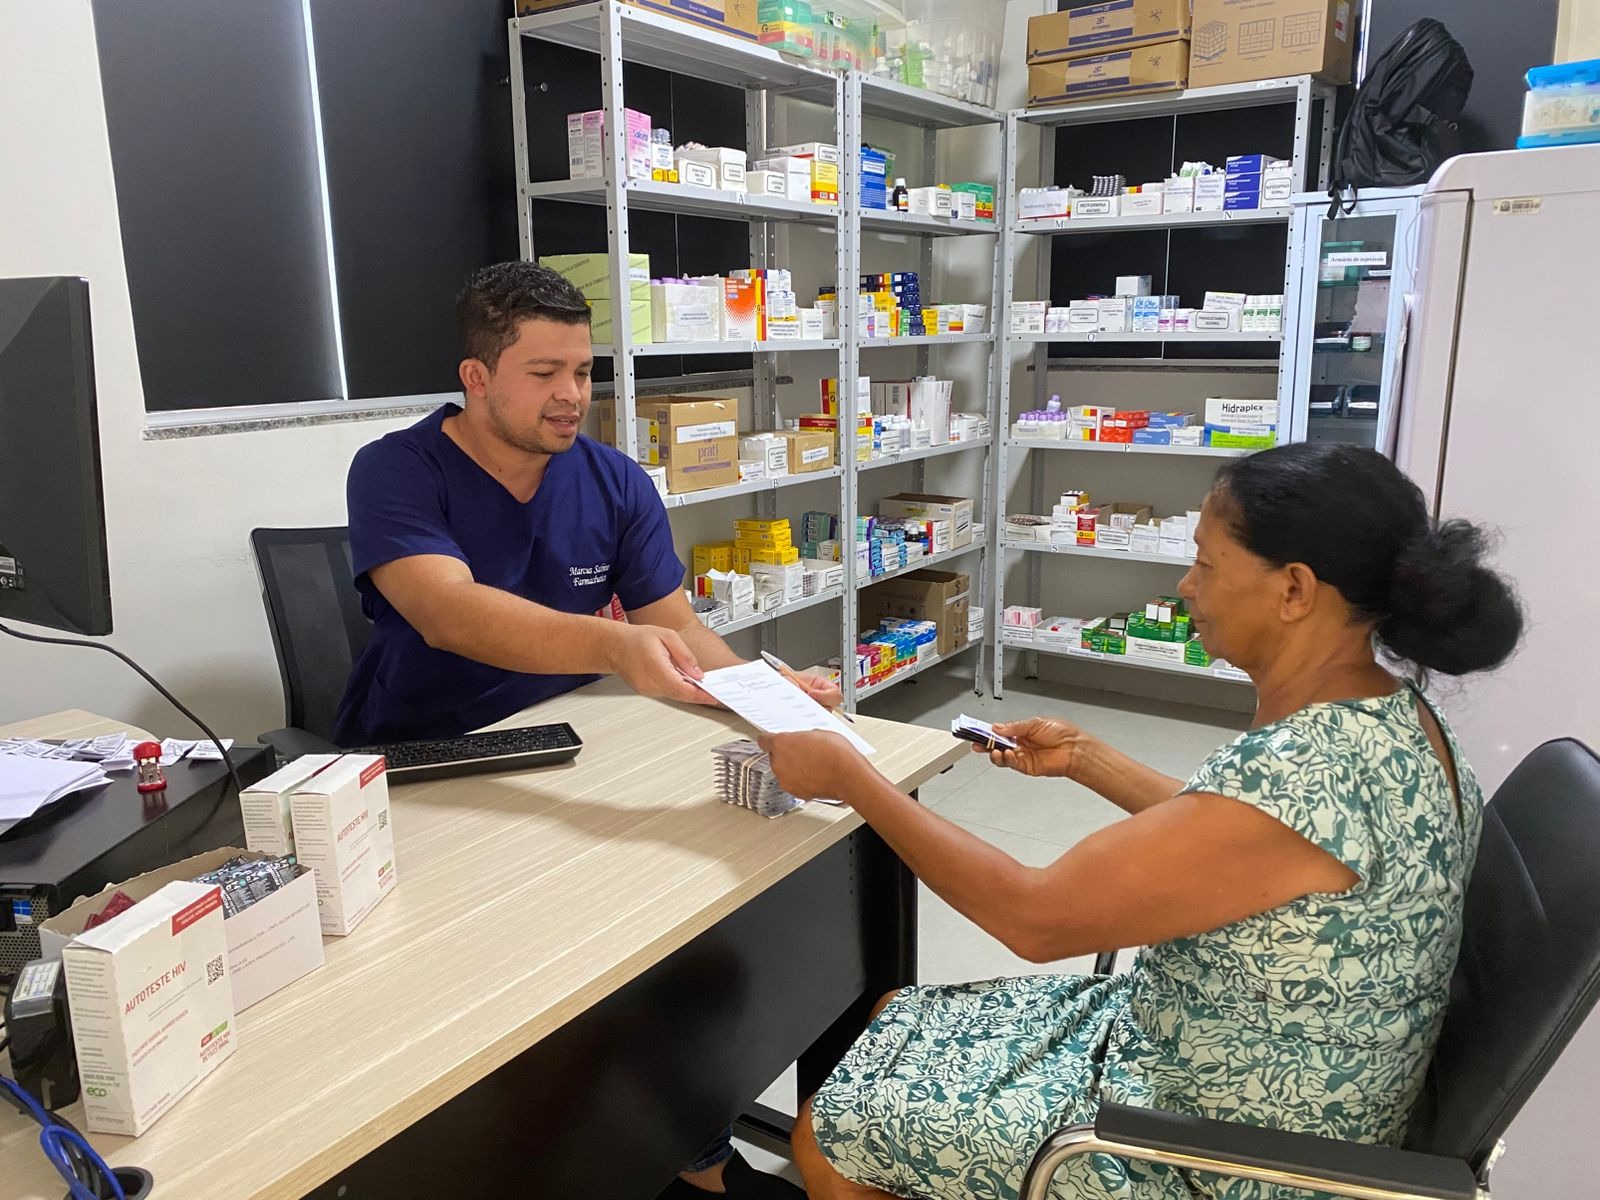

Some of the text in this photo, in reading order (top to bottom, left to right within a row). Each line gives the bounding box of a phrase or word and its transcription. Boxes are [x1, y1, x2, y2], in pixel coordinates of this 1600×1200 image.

[761, 24, 769, 32] G
[1225, 211, 1232, 219] N
[1056, 220, 1064, 228] M
[1222, 403, 1264, 413] Hidraplex
[698, 443, 719, 463] prati
[1052, 544, 1059, 552] S
[569, 566, 593, 576] Marcus
[337, 808, 369, 843] AUTOTESTE HIV
[124, 960, 187, 1015] AUTOTESTE HIV
[86, 1086, 107, 1097] eco
